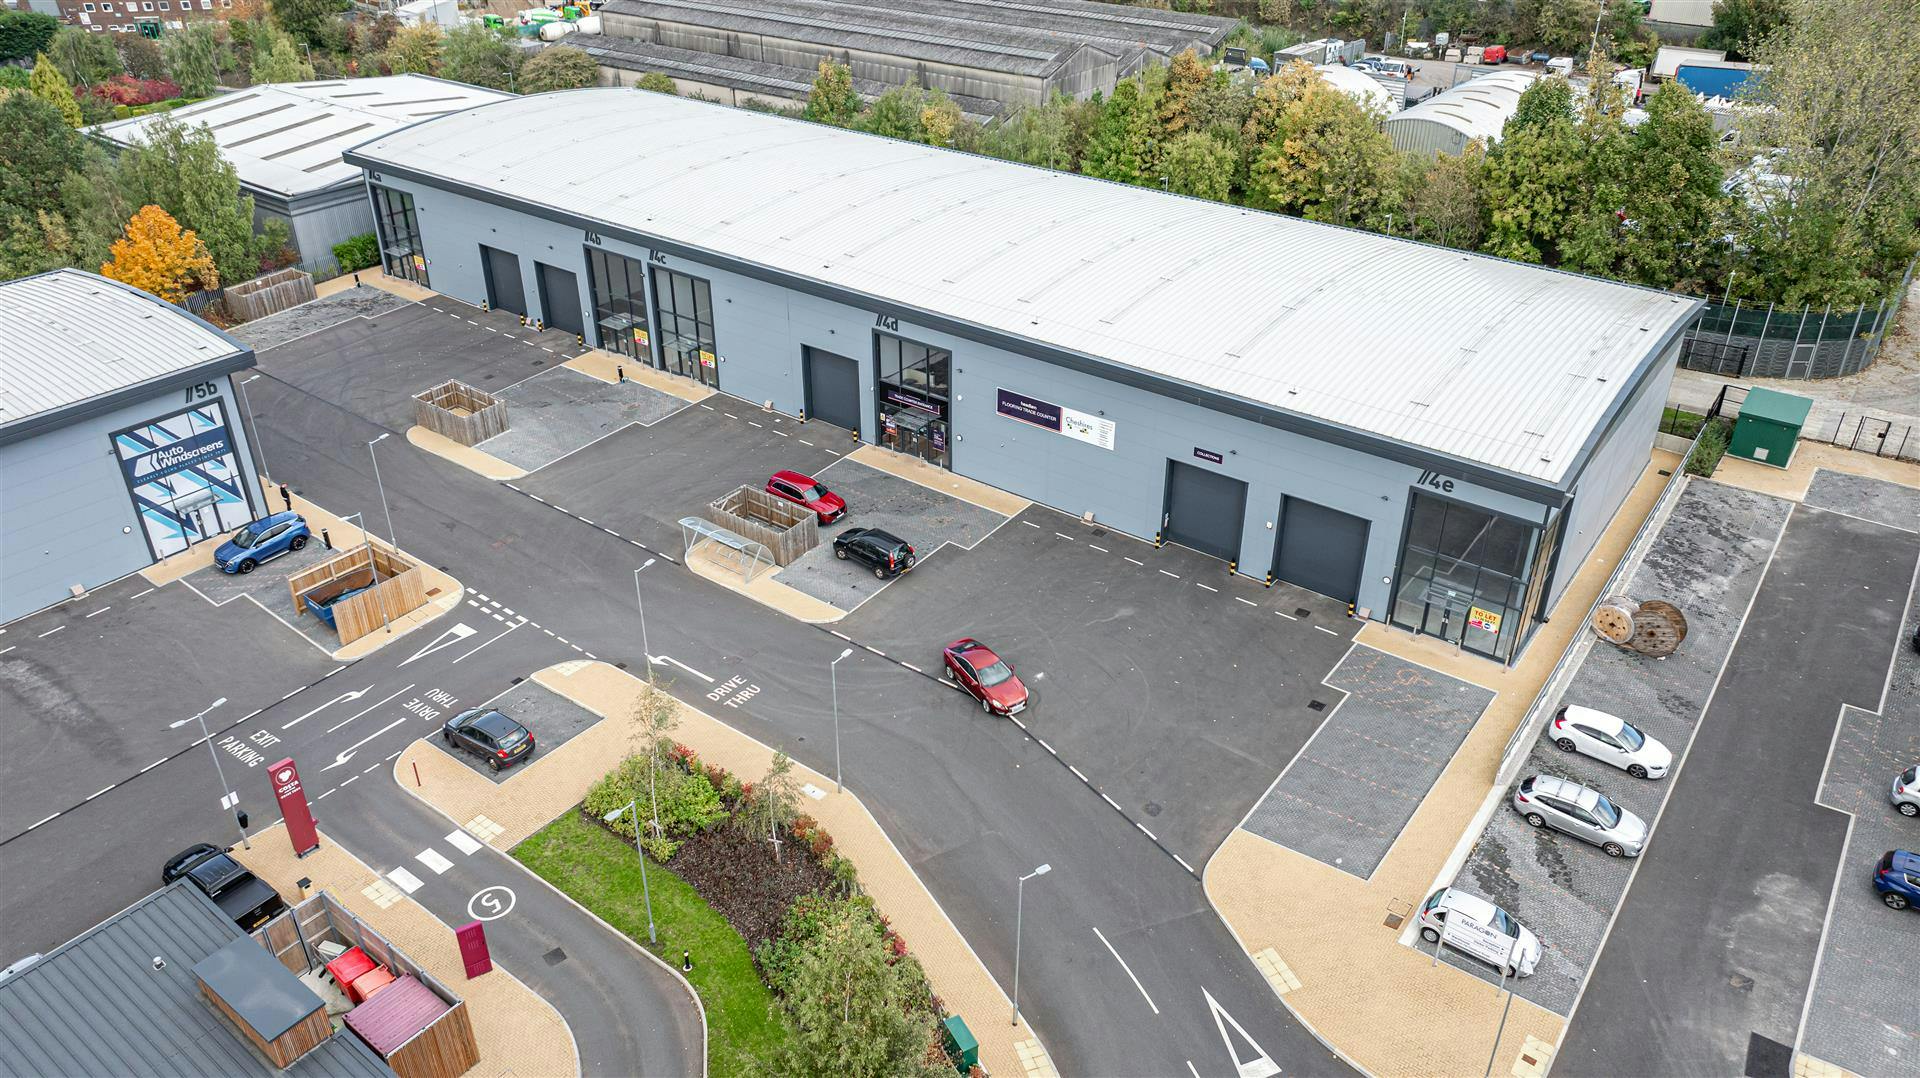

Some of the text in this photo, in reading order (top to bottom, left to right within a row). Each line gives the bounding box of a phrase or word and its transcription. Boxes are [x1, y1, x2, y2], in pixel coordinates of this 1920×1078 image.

[1036, 412, 1057, 422] COUNTER
[158, 445, 184, 460] Auto
[160, 439, 224, 468] Windscreens
[1484, 613, 1497, 621] LET
[424, 688, 459, 709] THRU
[706, 674, 748, 702] DRIVE
[723, 684, 761, 708] THRU
[403, 697, 441, 721] DRIVE
[249, 729, 282, 749] EXIT
[217, 735, 265, 768] PARKING
[278, 780, 300, 793] COSTA
[481, 892, 502, 914] 5
